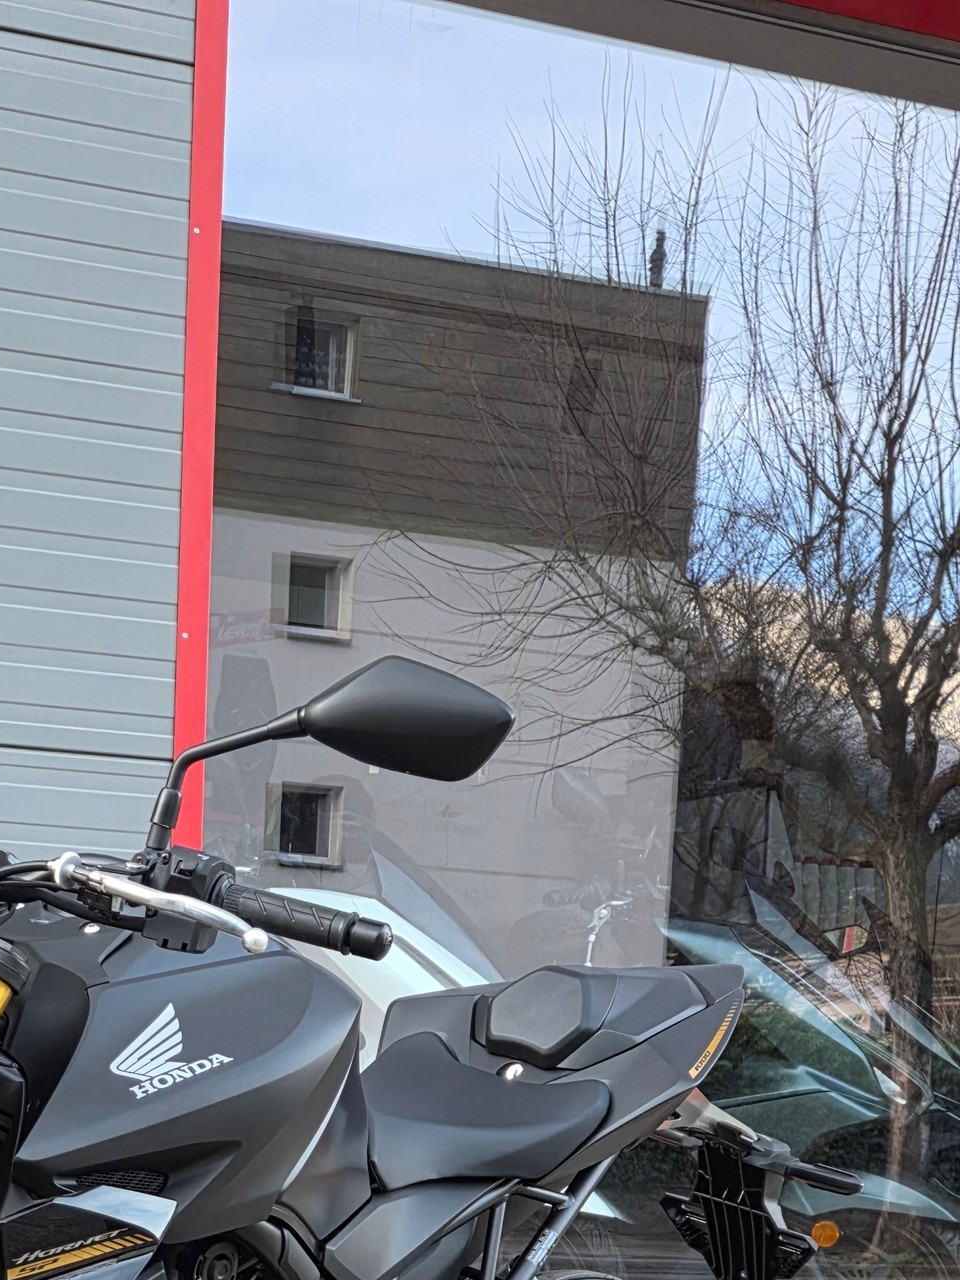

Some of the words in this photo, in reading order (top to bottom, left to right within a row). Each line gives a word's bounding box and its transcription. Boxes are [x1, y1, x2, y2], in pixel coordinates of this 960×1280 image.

[129, 1053, 234, 1099] HONDA
[694, 1050, 712, 1072] 1000
[12, 1227, 129, 1265] HORNET
[16, 1257, 60, 1277] SP
